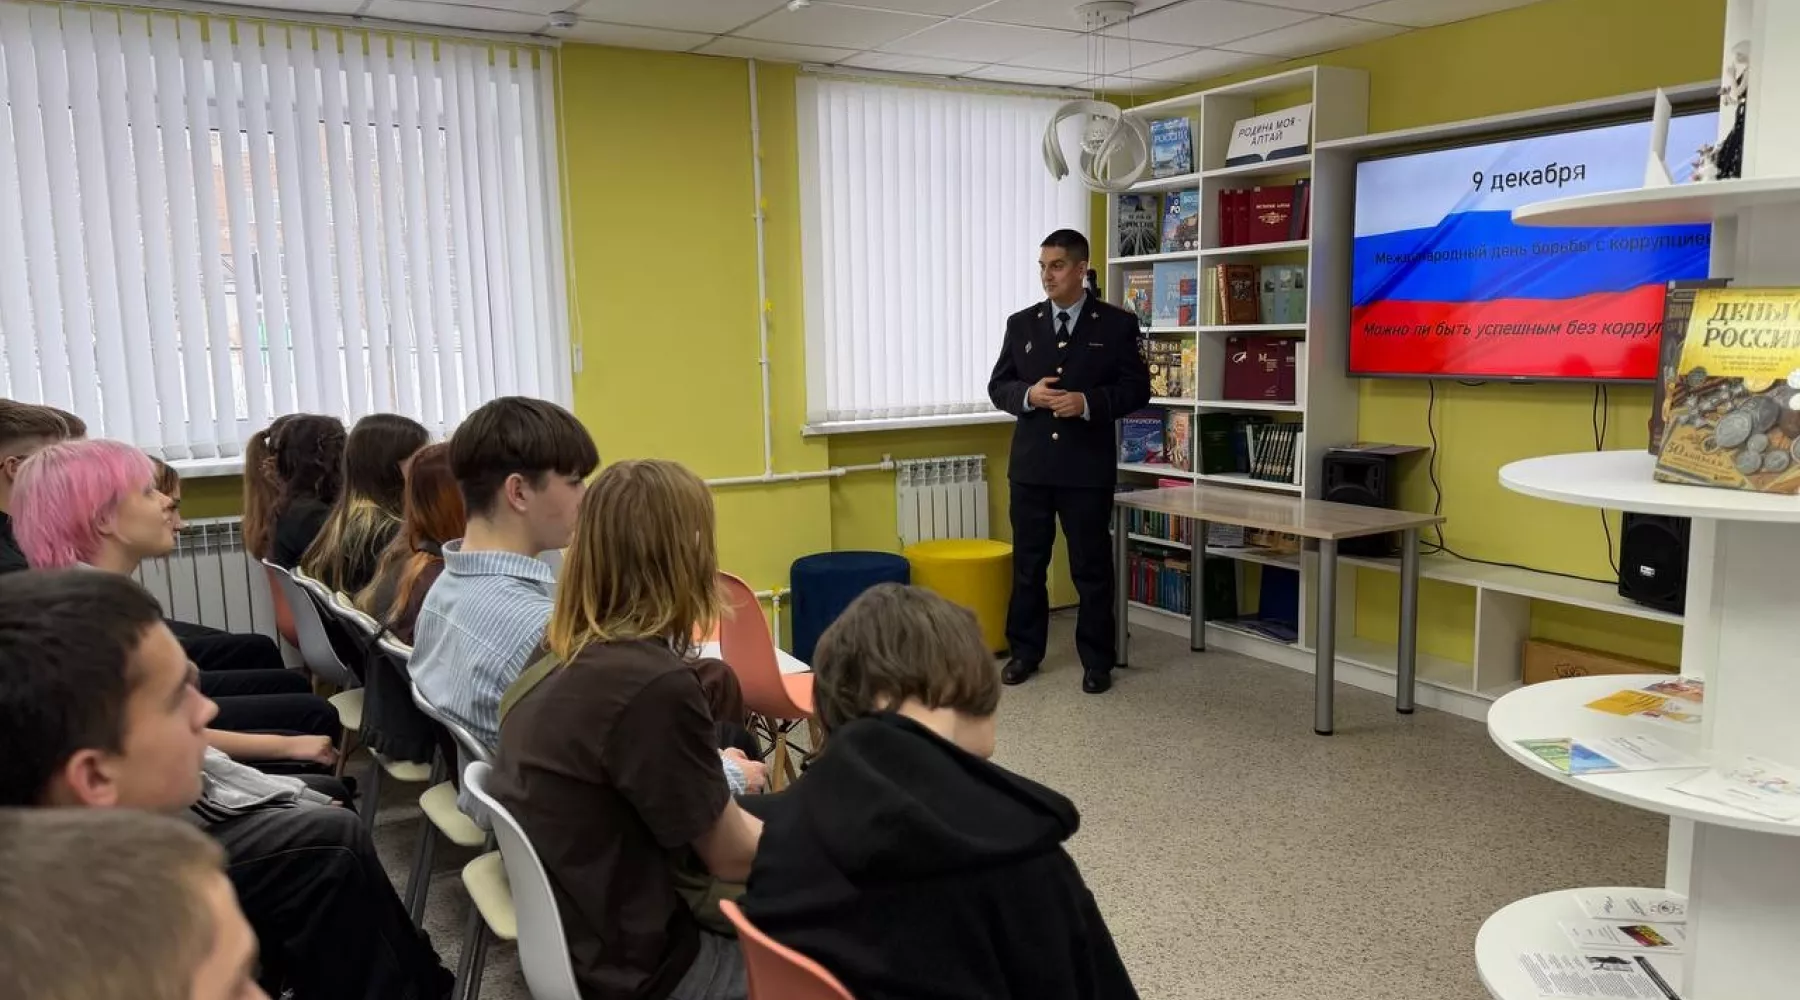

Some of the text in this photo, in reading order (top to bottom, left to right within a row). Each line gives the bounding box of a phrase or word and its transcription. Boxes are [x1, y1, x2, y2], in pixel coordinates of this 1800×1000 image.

[1238, 122, 1274, 138] РОДИНА
[1276, 117, 1296, 129] МОЯ
[1250, 130, 1283, 146] АЛТАЙ
[1472, 162, 1586, 192] 9 декабря
[1490, 246, 1527, 260] день
[1532, 239, 1589, 257] борьбы
[1596, 240, 1605, 251] с
[1364, 323, 1410, 337] Можно
[1415, 324, 1431, 336] ли
[1435, 321, 1472, 336] быть
[1475, 323, 1561, 339] успешным
[1566, 319, 1597, 335] без
